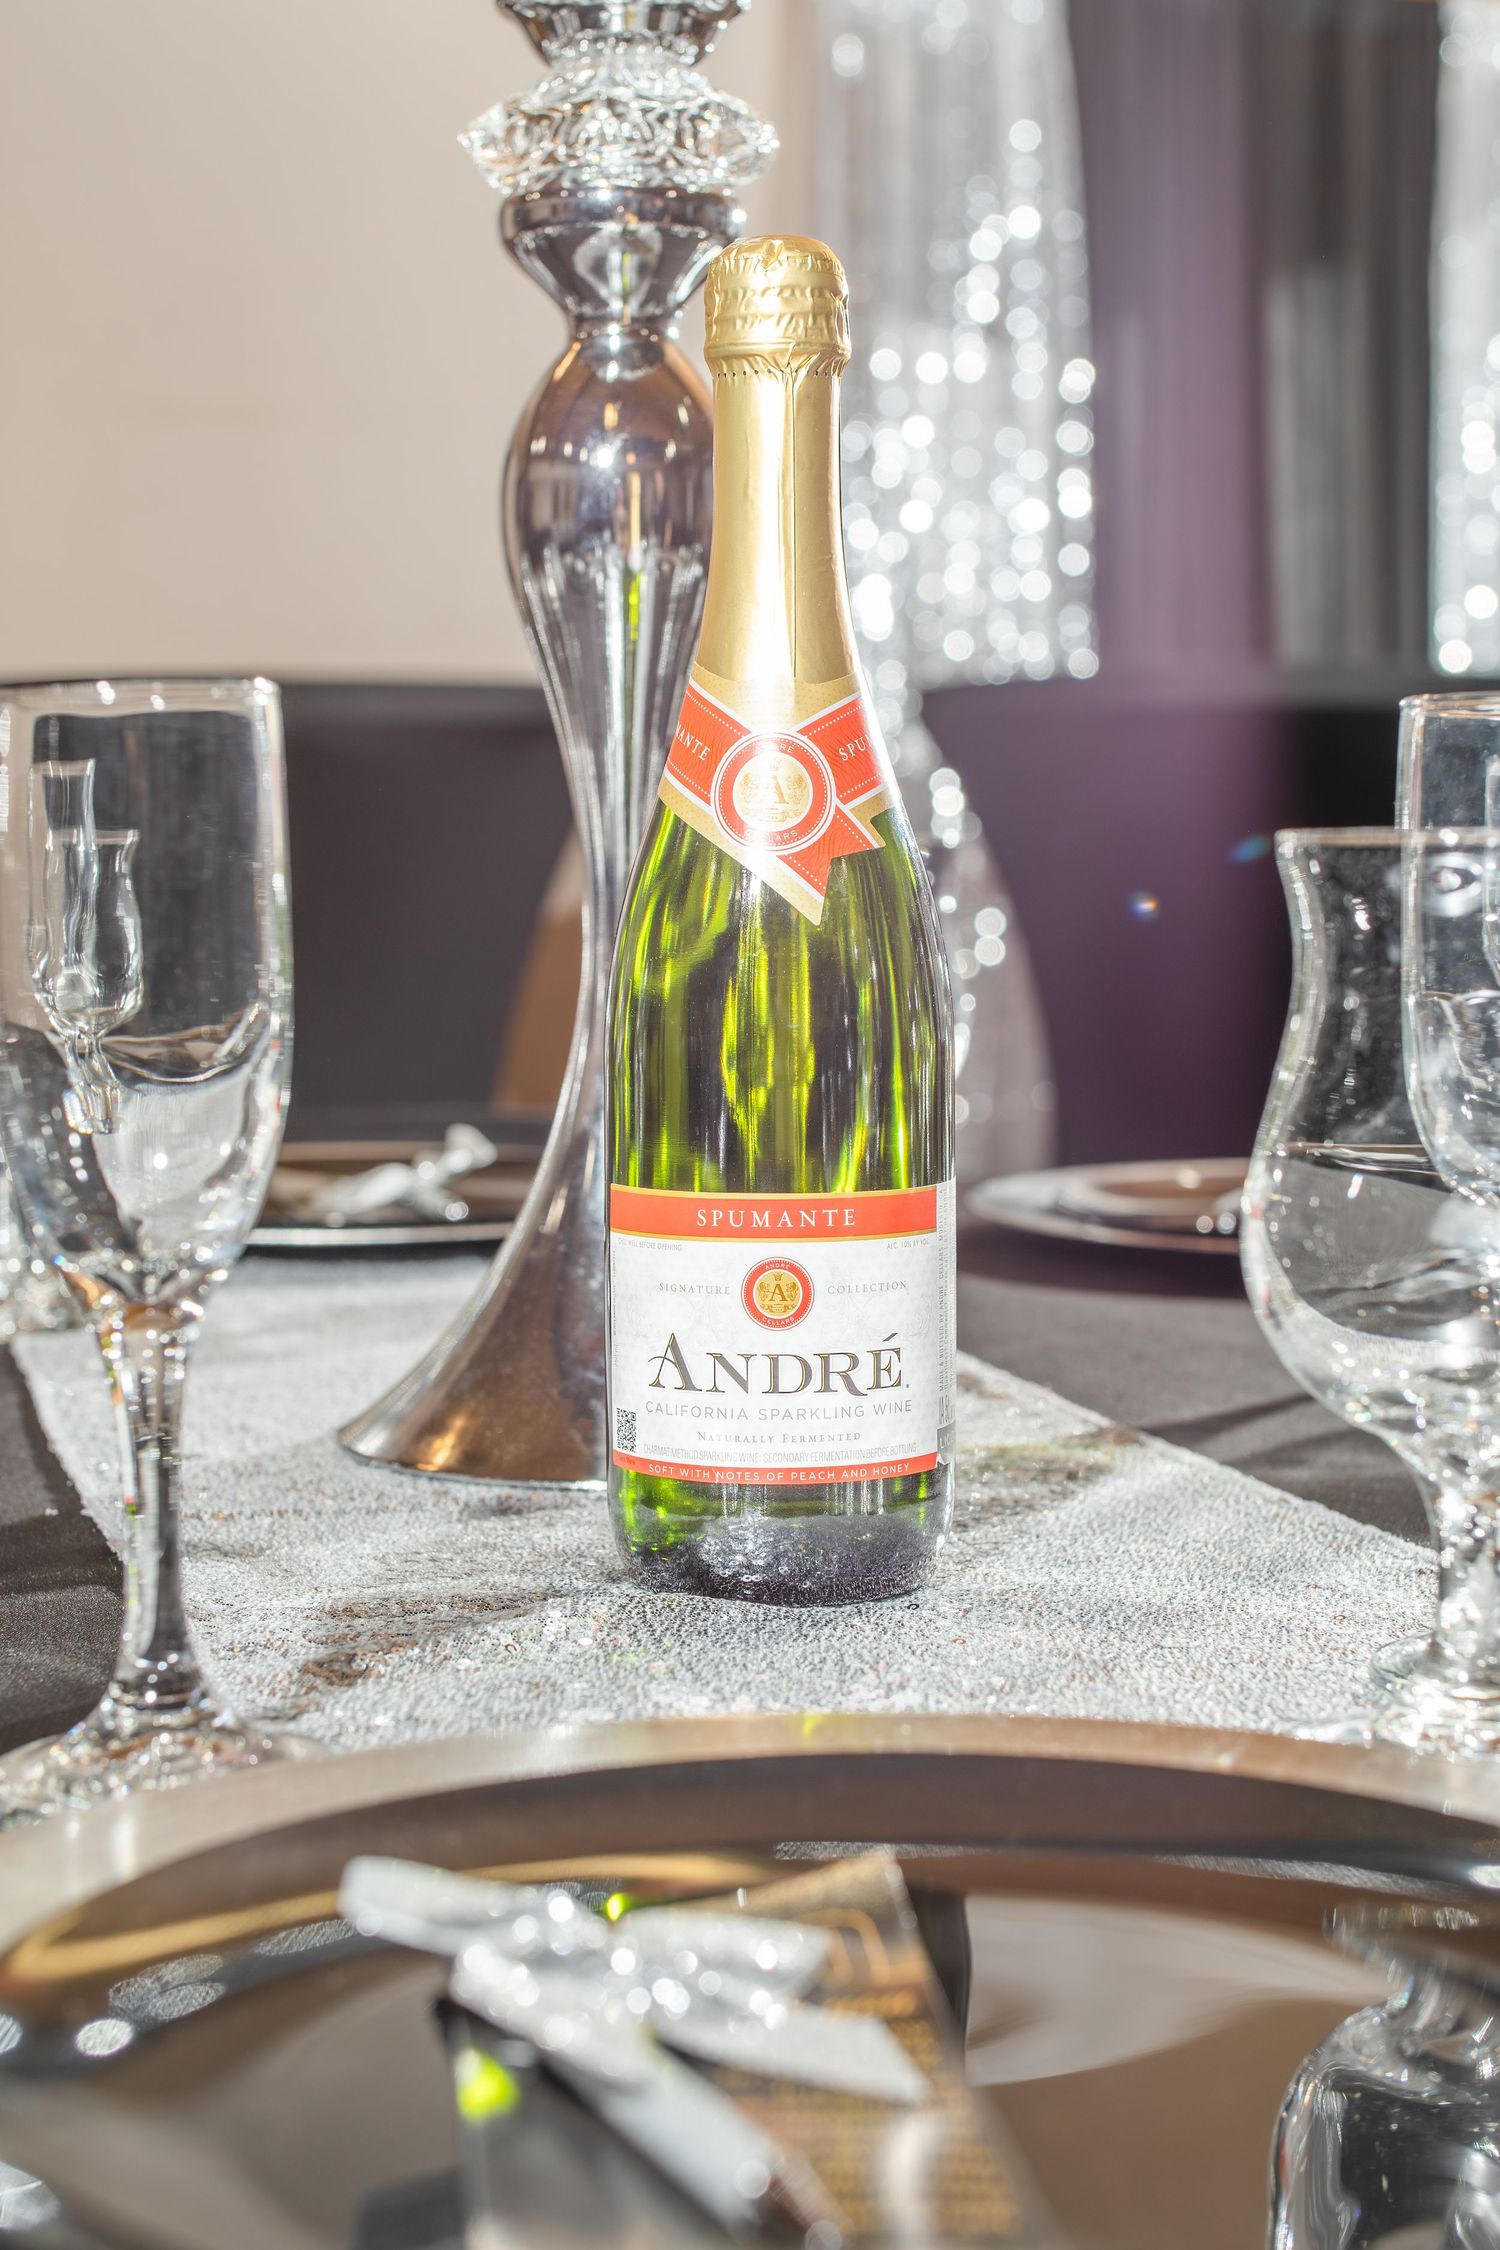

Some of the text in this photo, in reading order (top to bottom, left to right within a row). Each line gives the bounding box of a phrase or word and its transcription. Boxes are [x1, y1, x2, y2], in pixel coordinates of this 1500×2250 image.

[696, 1208, 856, 1228] SPUMANTE
[658, 1280, 907, 1295] SIGNATURE COLLECTION
[768, 1283, 788, 1302] A
[762, 1315, 796, 1327] CELLARS
[645, 1399, 912, 1421] CALIFORNIA SPARKLING WINE
[643, 1443, 670, 1458] CHARMAT
[671, 1447, 698, 1461] METHOD
[699, 1449, 738, 1463] SPARKLING
[763, 1451, 809, 1463] SECONDARY
[810, 1448, 865, 1462] FERMENTATION
[866, 1445, 890, 1459] BEFORE
[648, 1462, 910, 1482] SOFT WITH NOTES OF PEACH AND HONEY
